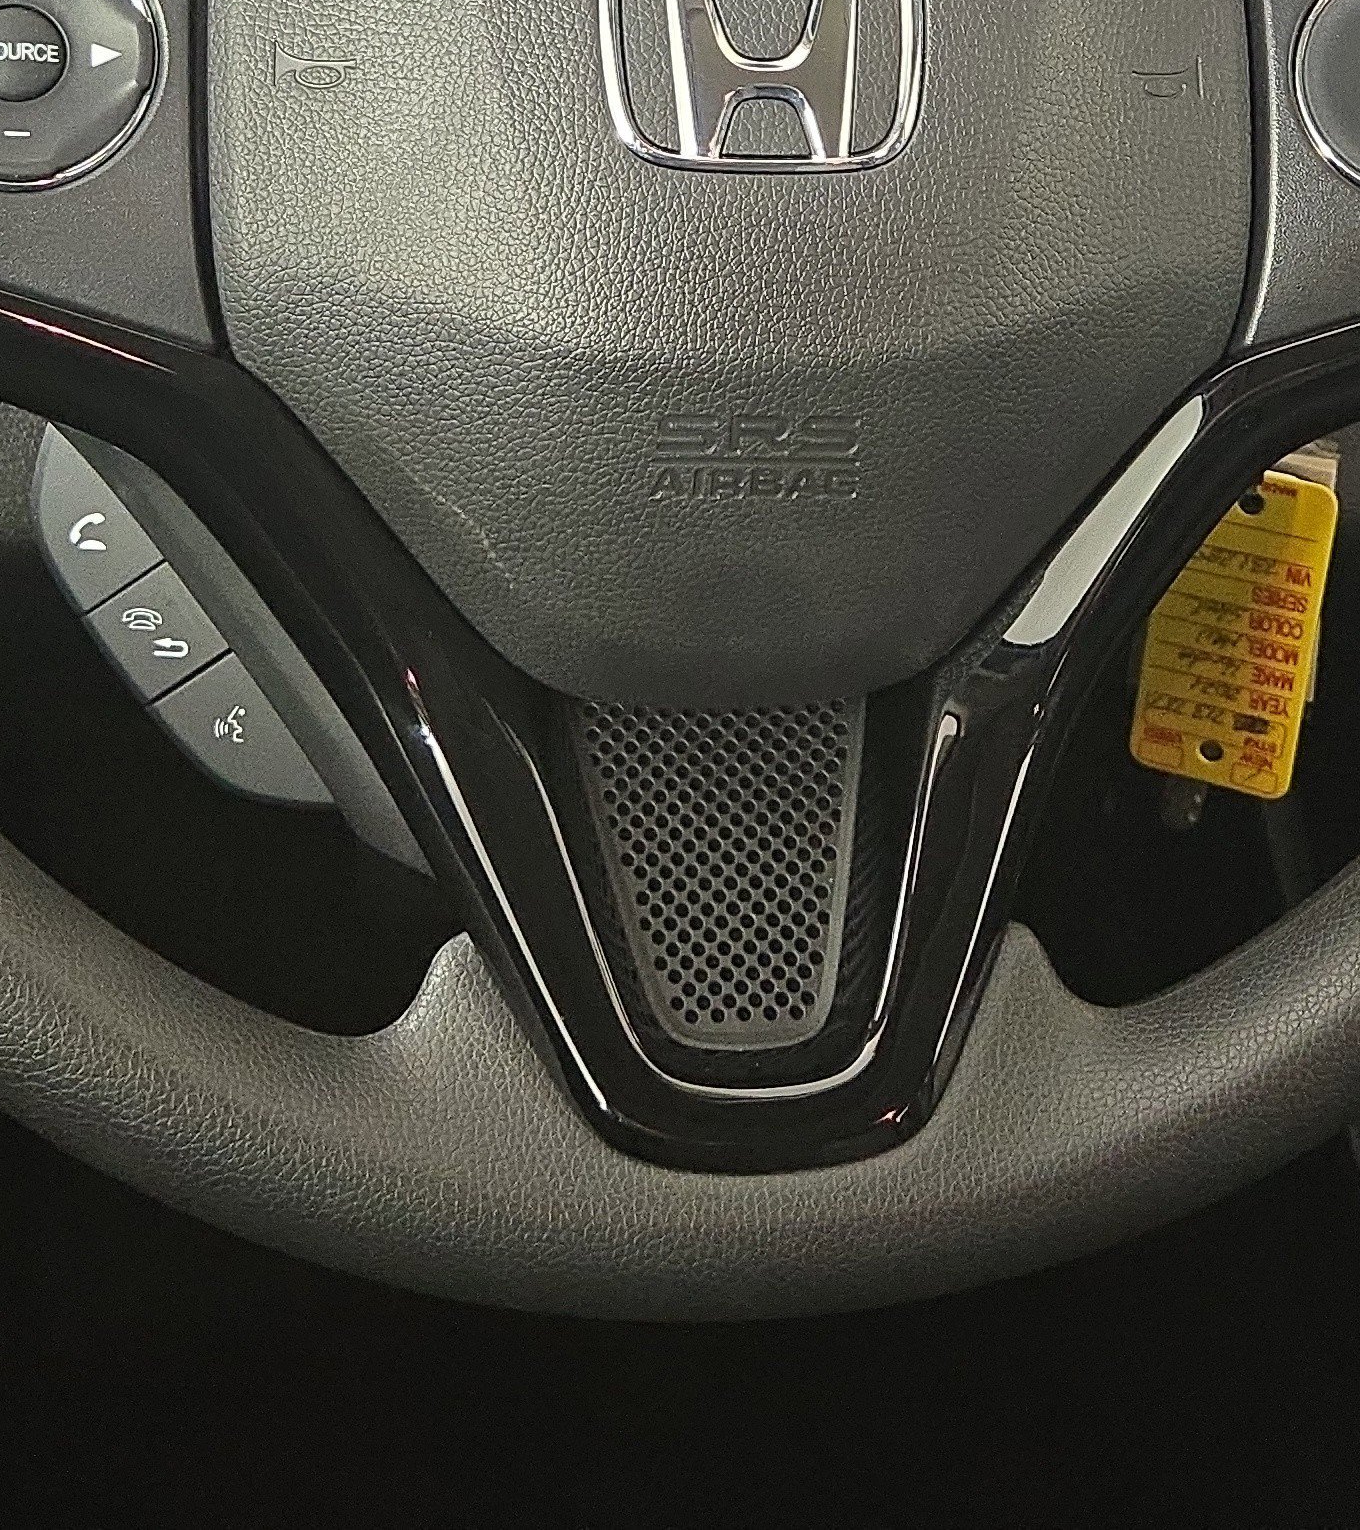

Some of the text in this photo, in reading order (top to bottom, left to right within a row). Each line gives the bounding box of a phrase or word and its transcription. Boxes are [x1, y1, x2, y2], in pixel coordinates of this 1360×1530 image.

[656, 415, 861, 457] SRS
[648, 469, 860, 501] AIRBAG
[1285, 565, 1312, 586] VIN
[1248, 612, 1303, 639] COLOR
[1248, 693, 1289, 717] YEAR
